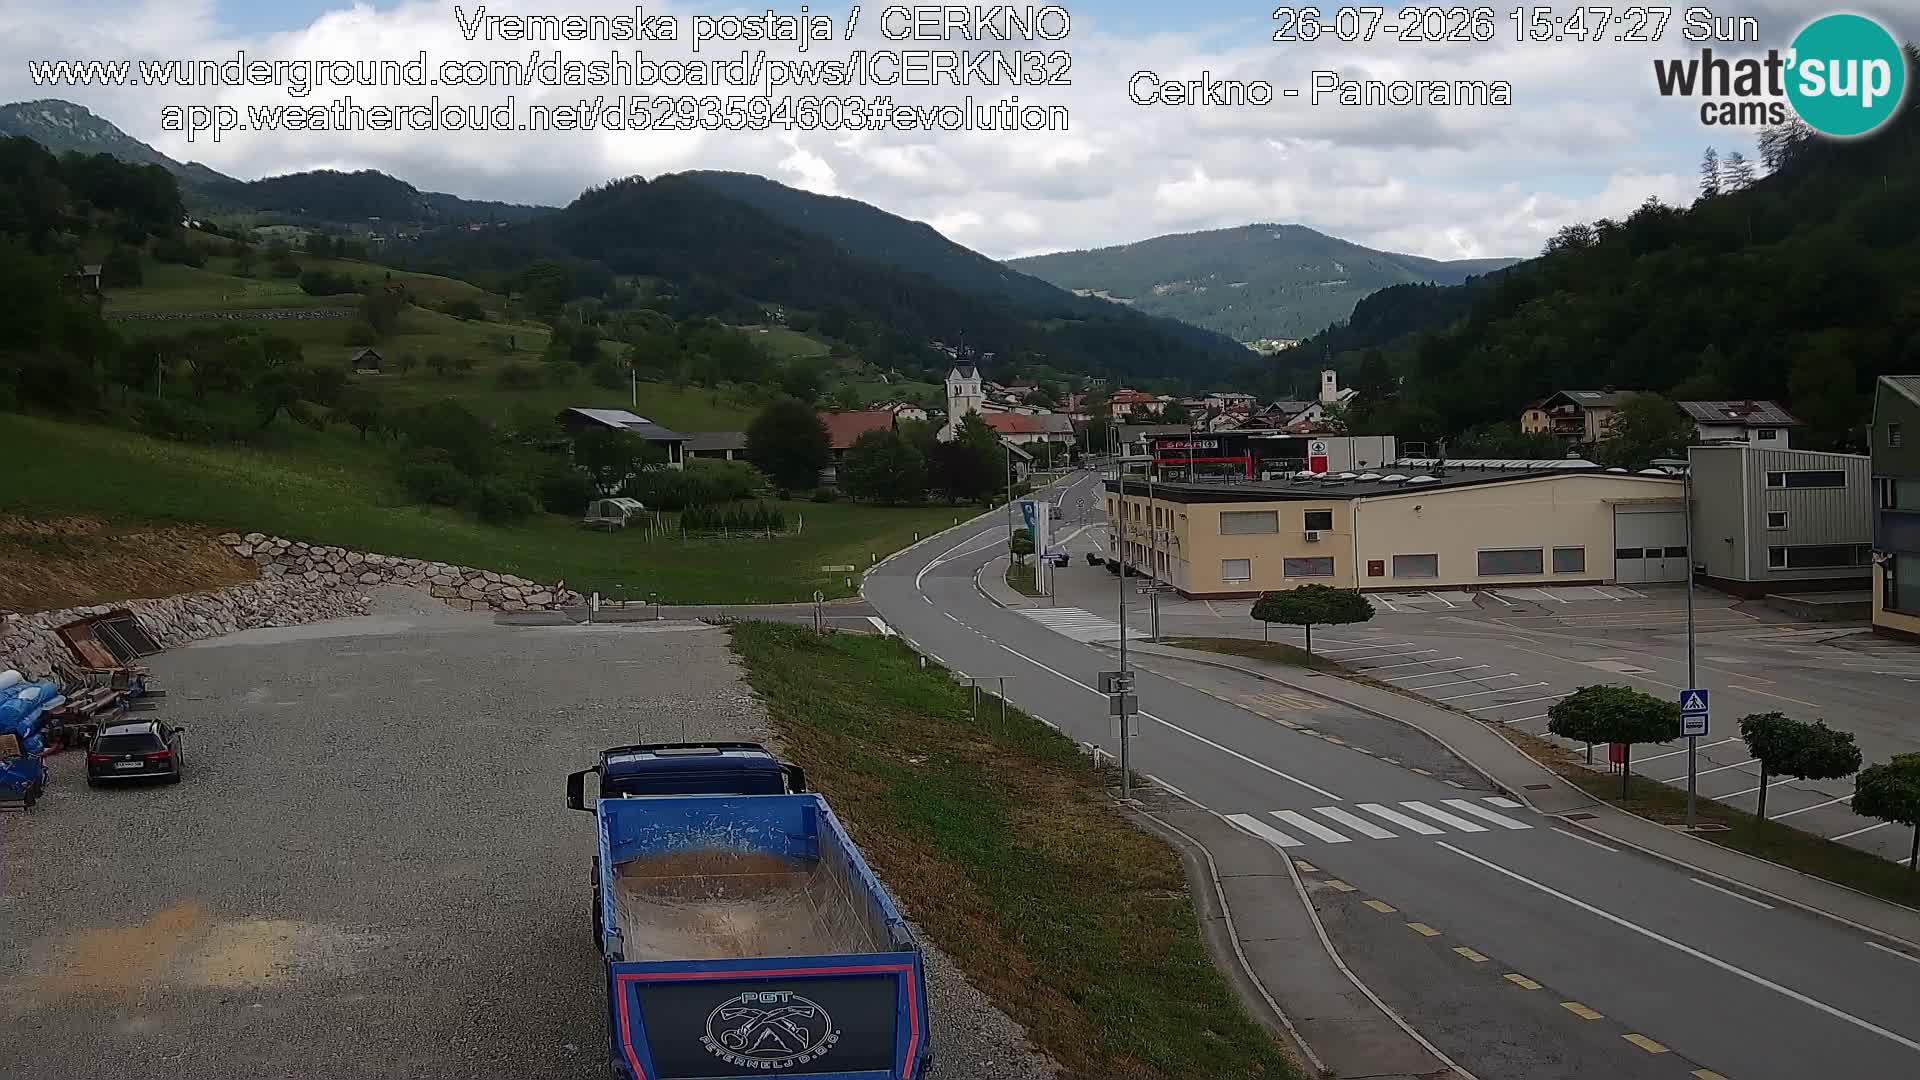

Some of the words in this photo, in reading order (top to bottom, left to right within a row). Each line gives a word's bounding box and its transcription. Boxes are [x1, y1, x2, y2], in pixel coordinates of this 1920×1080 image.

[1166, 440, 1202, 449] SPAR
[741, 991, 793, 1004] PGT
[699, 1035, 794, 1069] PETERNELJ
